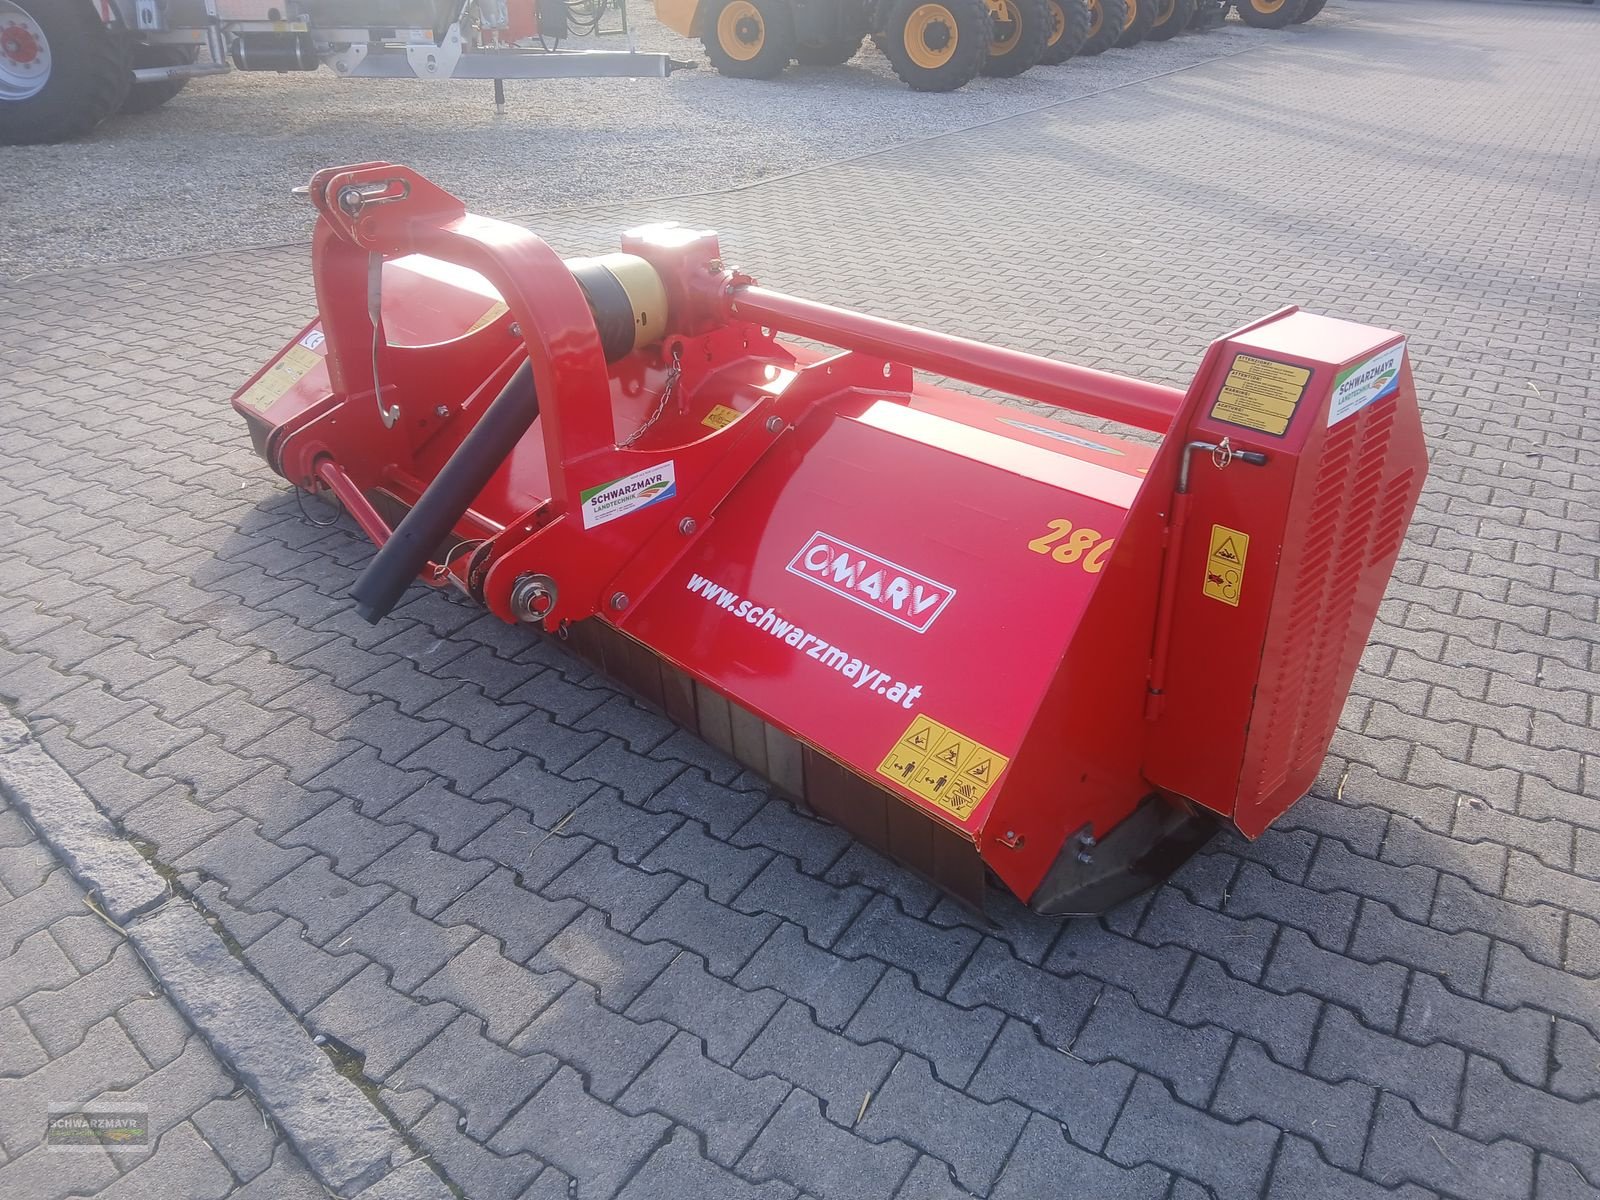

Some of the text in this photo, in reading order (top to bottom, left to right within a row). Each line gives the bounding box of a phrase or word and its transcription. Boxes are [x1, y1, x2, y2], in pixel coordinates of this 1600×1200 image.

[1339, 358, 1394, 395] SCHWARZMAYR
[591, 474, 662, 506] SCHWARZMAYR
[593, 495, 637, 513] LANDTECHNIK
[804, 544, 940, 617] OMARV
[686, 573, 923, 709] www.schwarzmayr.at
